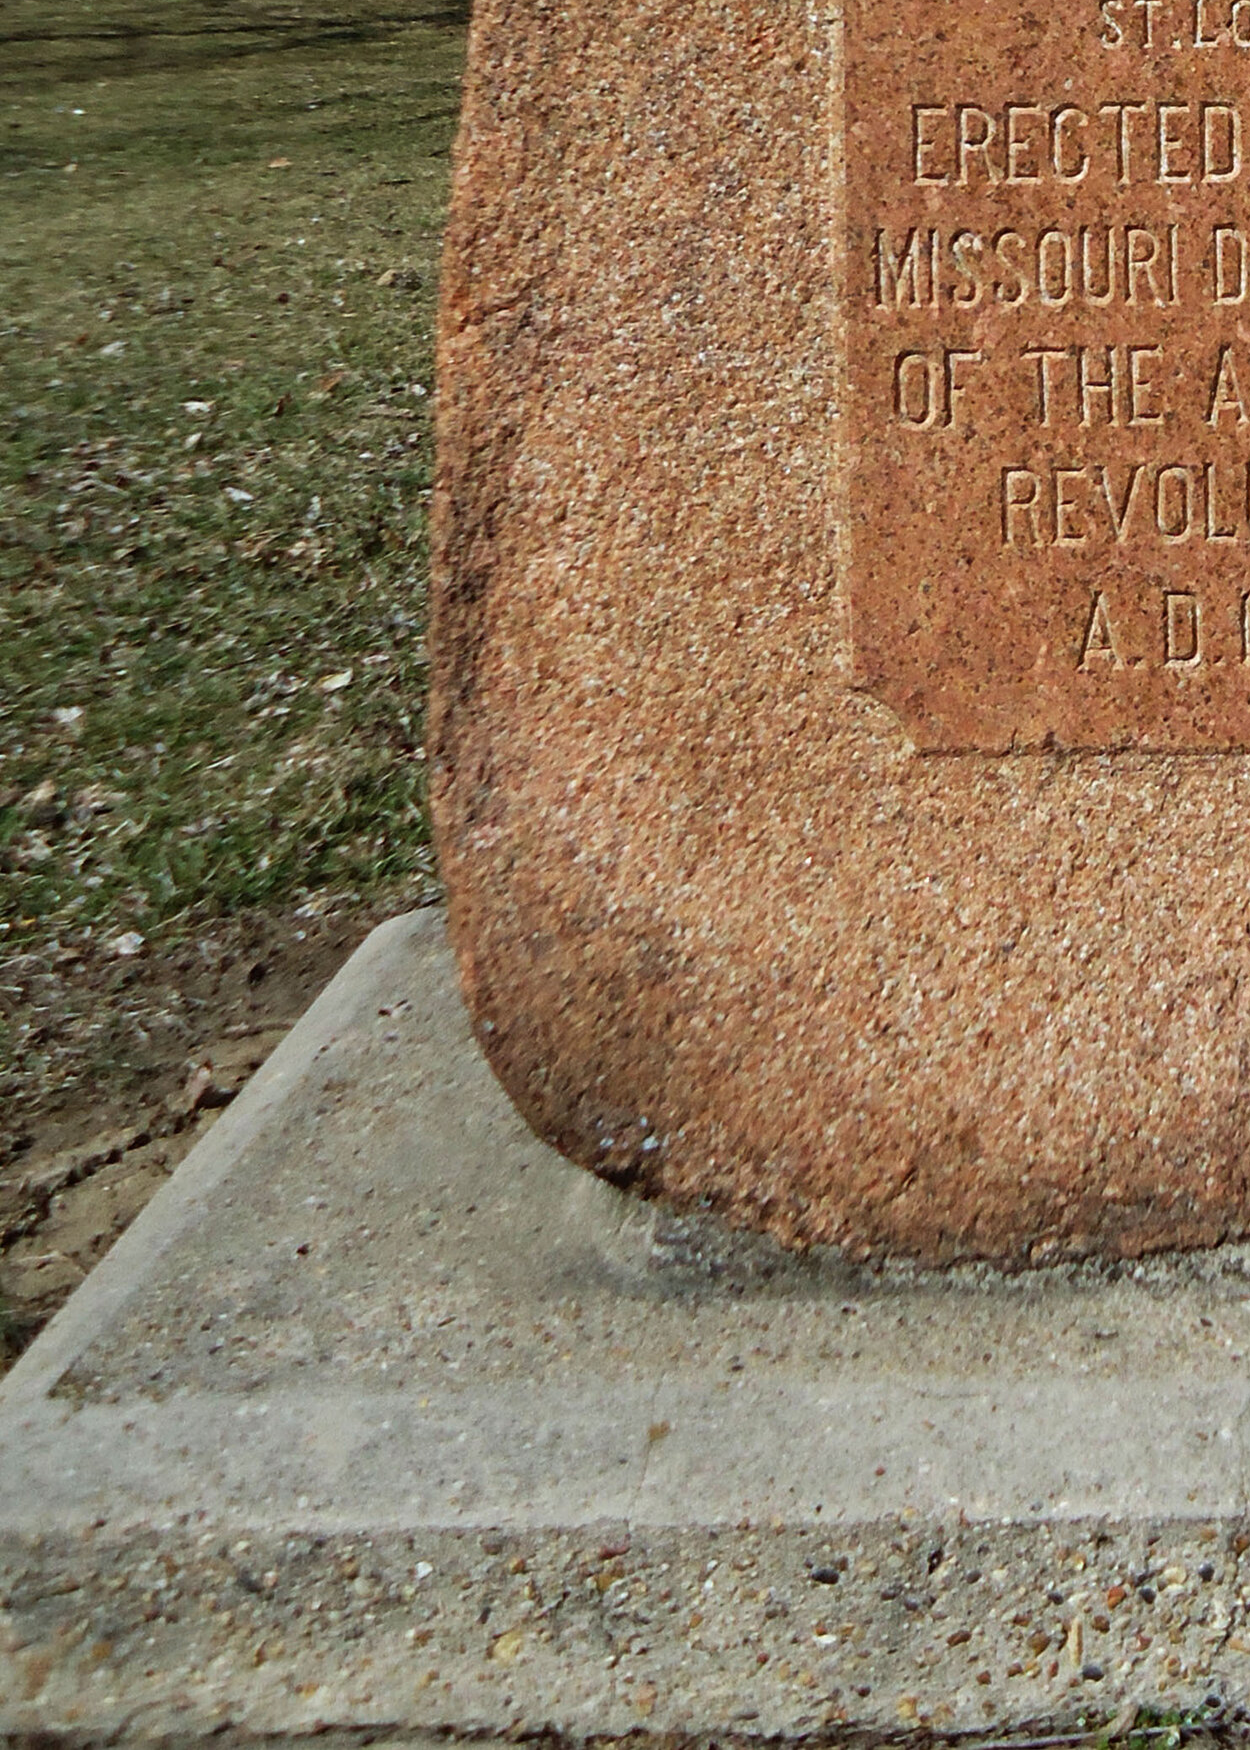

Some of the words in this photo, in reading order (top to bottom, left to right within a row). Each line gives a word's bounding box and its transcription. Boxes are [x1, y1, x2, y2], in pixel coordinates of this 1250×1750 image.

[912, 104, 1243, 186] ERECTED
[873, 225, 1181, 310] MISSOURI
[893, 350, 983, 431] OF
[1022, 346, 1164, 427] THE
